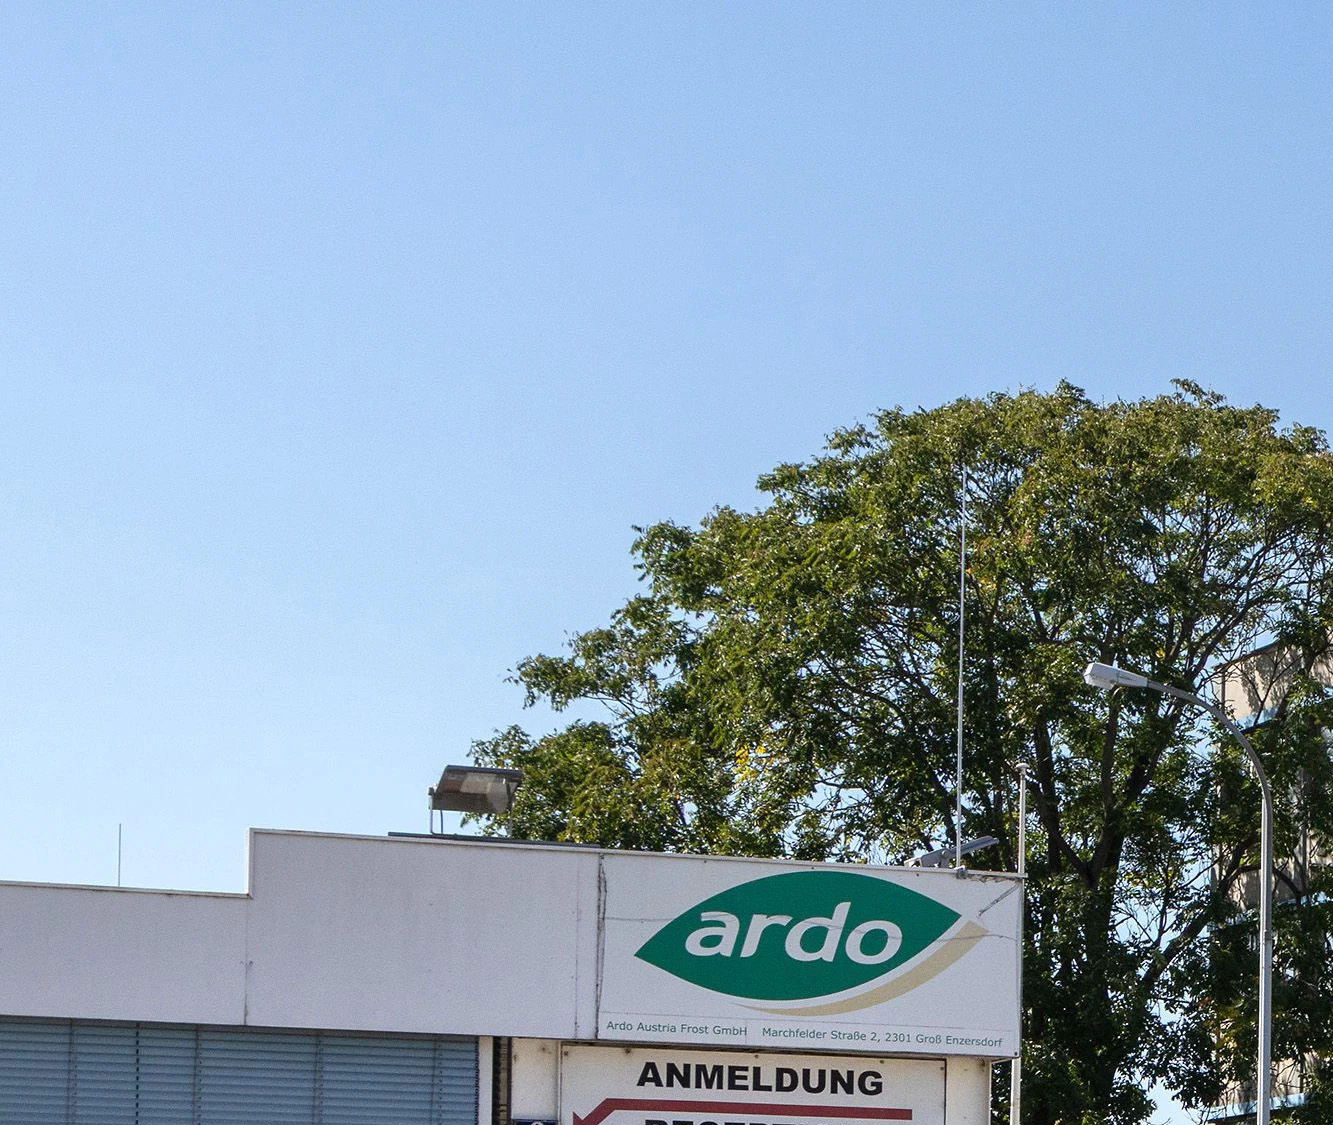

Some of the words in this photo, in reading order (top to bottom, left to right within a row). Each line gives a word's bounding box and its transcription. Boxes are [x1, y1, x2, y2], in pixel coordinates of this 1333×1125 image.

[684, 902, 904, 967] ardo
[606, 1021, 633, 1031] Ardo
[637, 1022, 677, 1033] Austria
[680, 1024, 709, 1035] Frost
[712, 1026, 748, 1036] GmbH
[762, 1027, 827, 1039] Marchfelder
[831, 1030, 867, 1041] Straße
[870, 1032, 881, 1043] 2,
[885, 1032, 912, 1043] 2301
[915, 1034, 942, 1044] Groß
[945, 1035, 1003, 1047] Enzersdorf
[636, 1061, 884, 1096] ANMELDUNG
